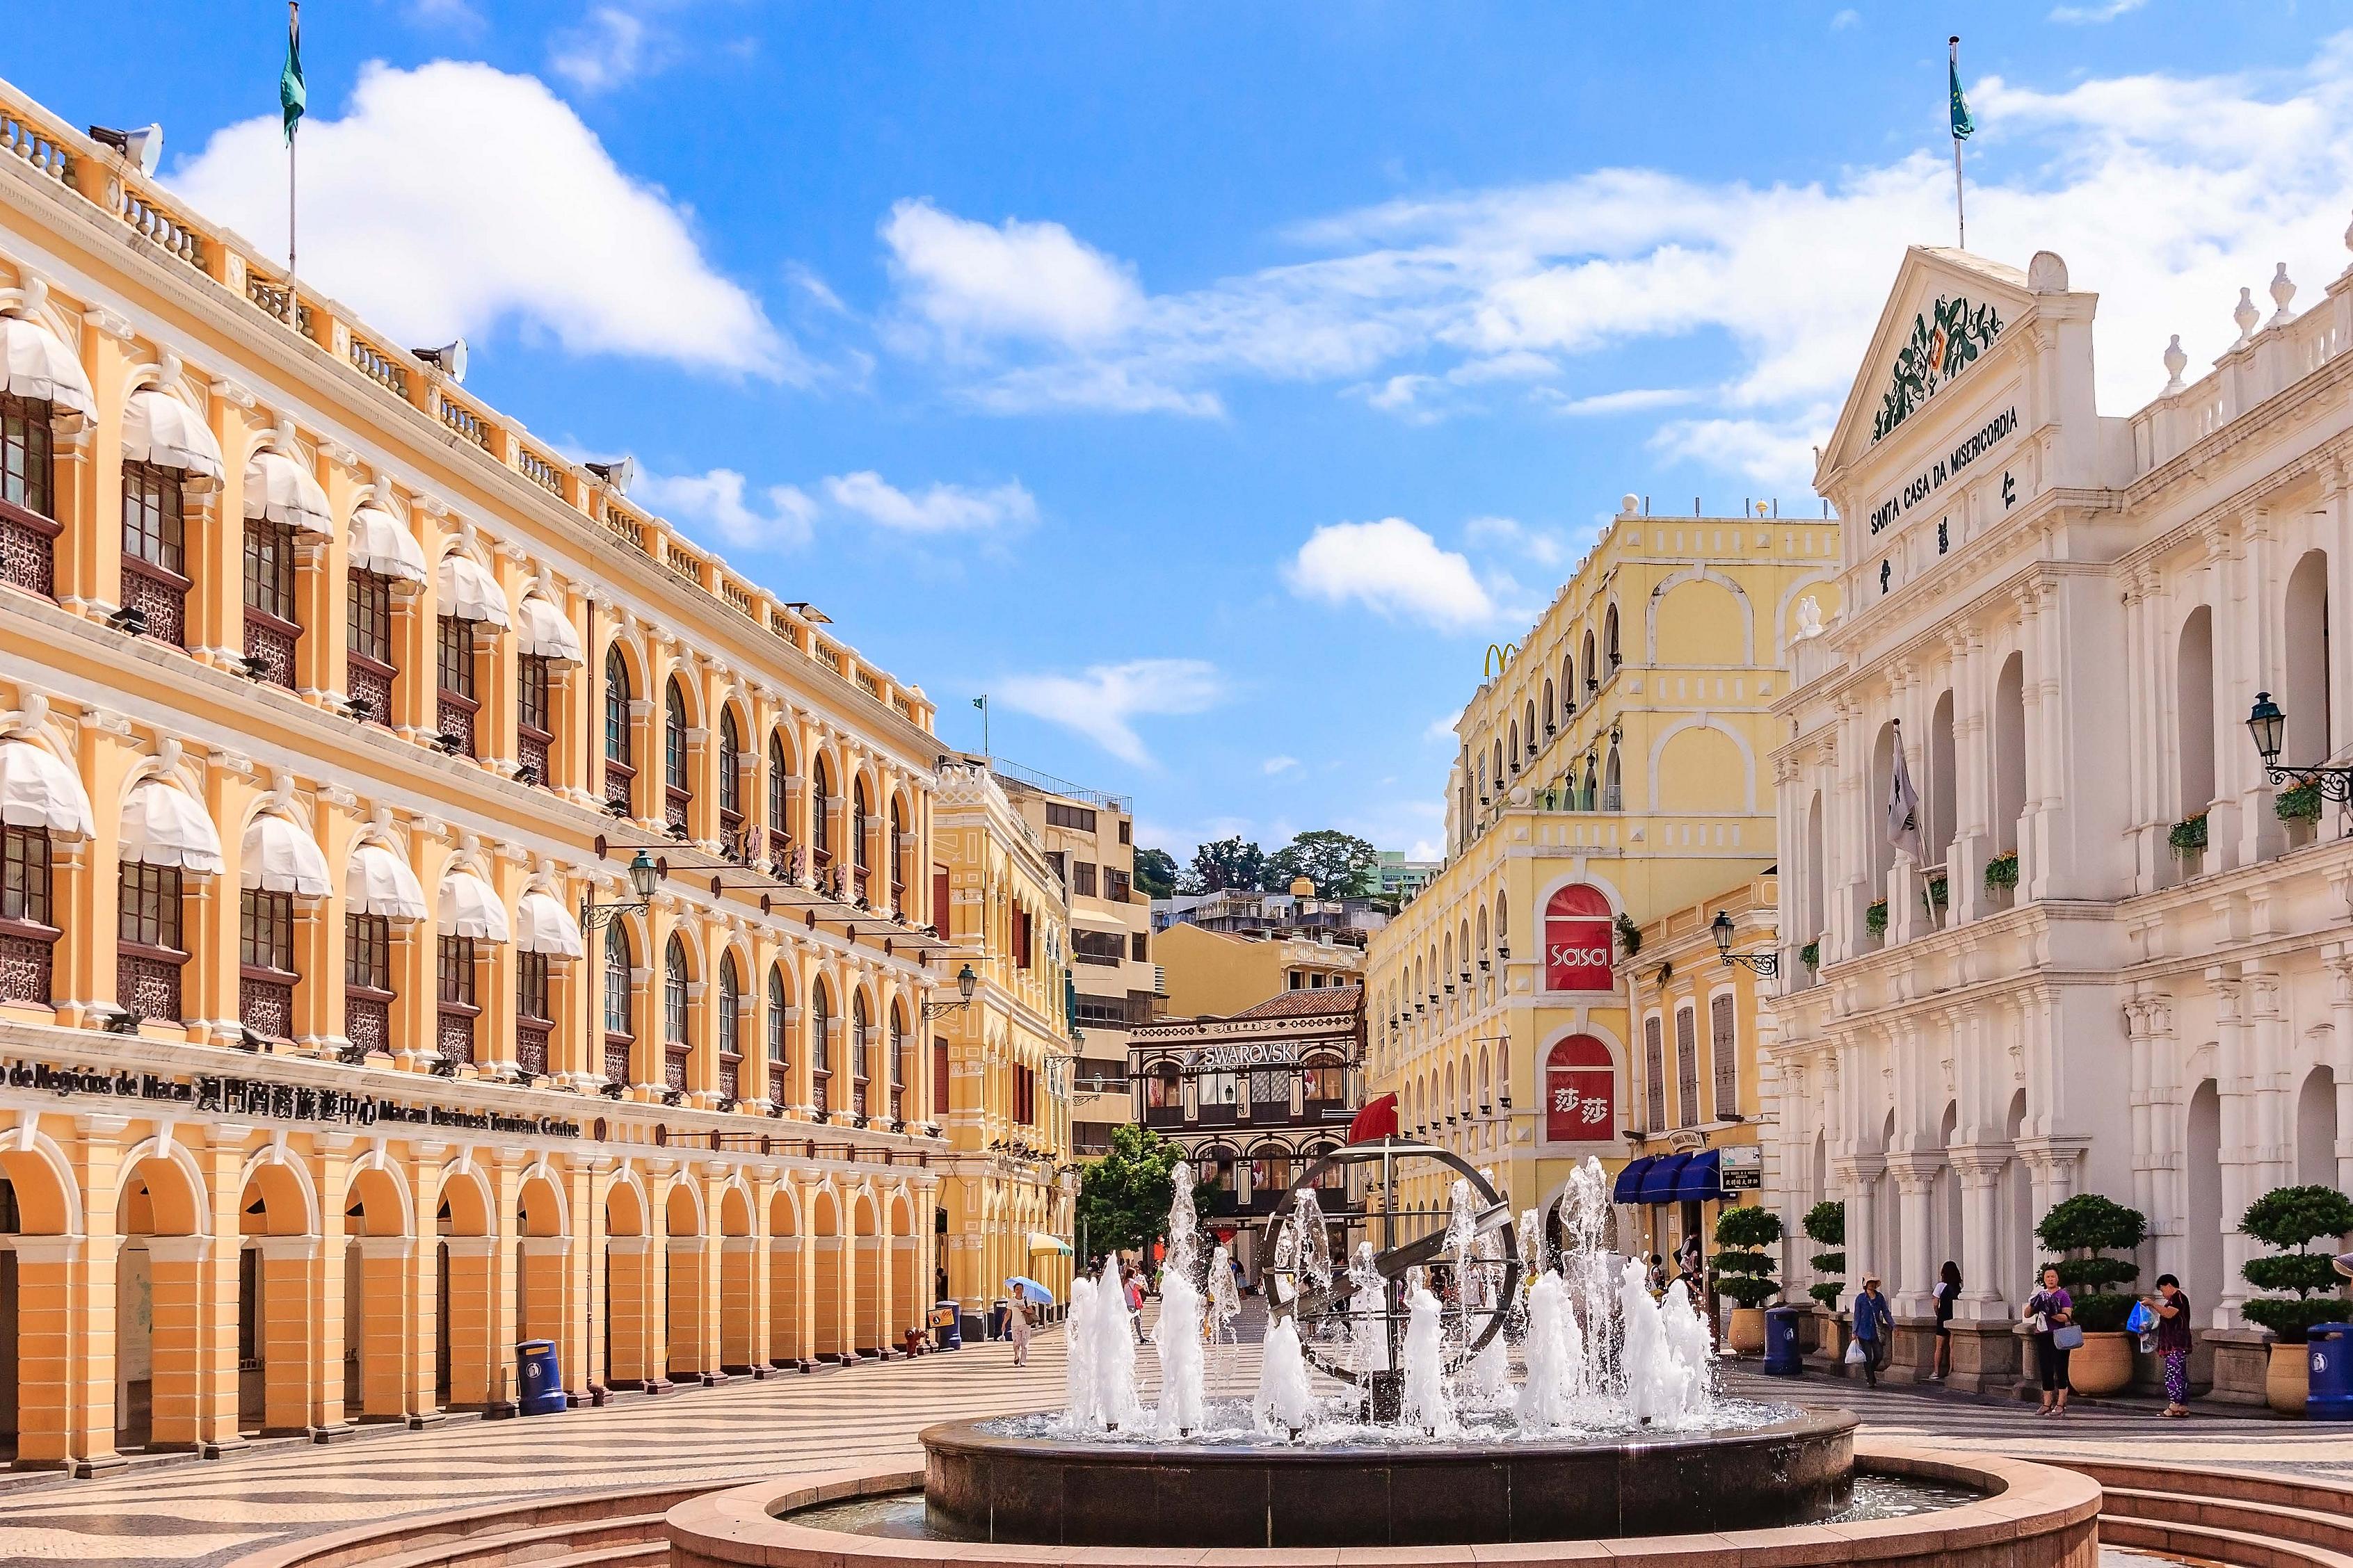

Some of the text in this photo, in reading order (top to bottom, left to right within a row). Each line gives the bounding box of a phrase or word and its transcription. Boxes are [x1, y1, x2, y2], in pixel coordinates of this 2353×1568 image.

[1870, 405, 2018, 535] SANTA CASA DA MISERICORDIA
[1205, 1043, 1299, 1065] SWAROVSKI
[10, 1060, 34, 1088] de
[115, 1070, 138, 1096] de
[142, 1074, 195, 1101] Macau
[195, 1076, 376, 1126] 澳門商務旅遊中心
[378, 1100, 580, 1138] Macau Business Tourism Centre
[1555, 1088, 1608, 1124] 莎莎
